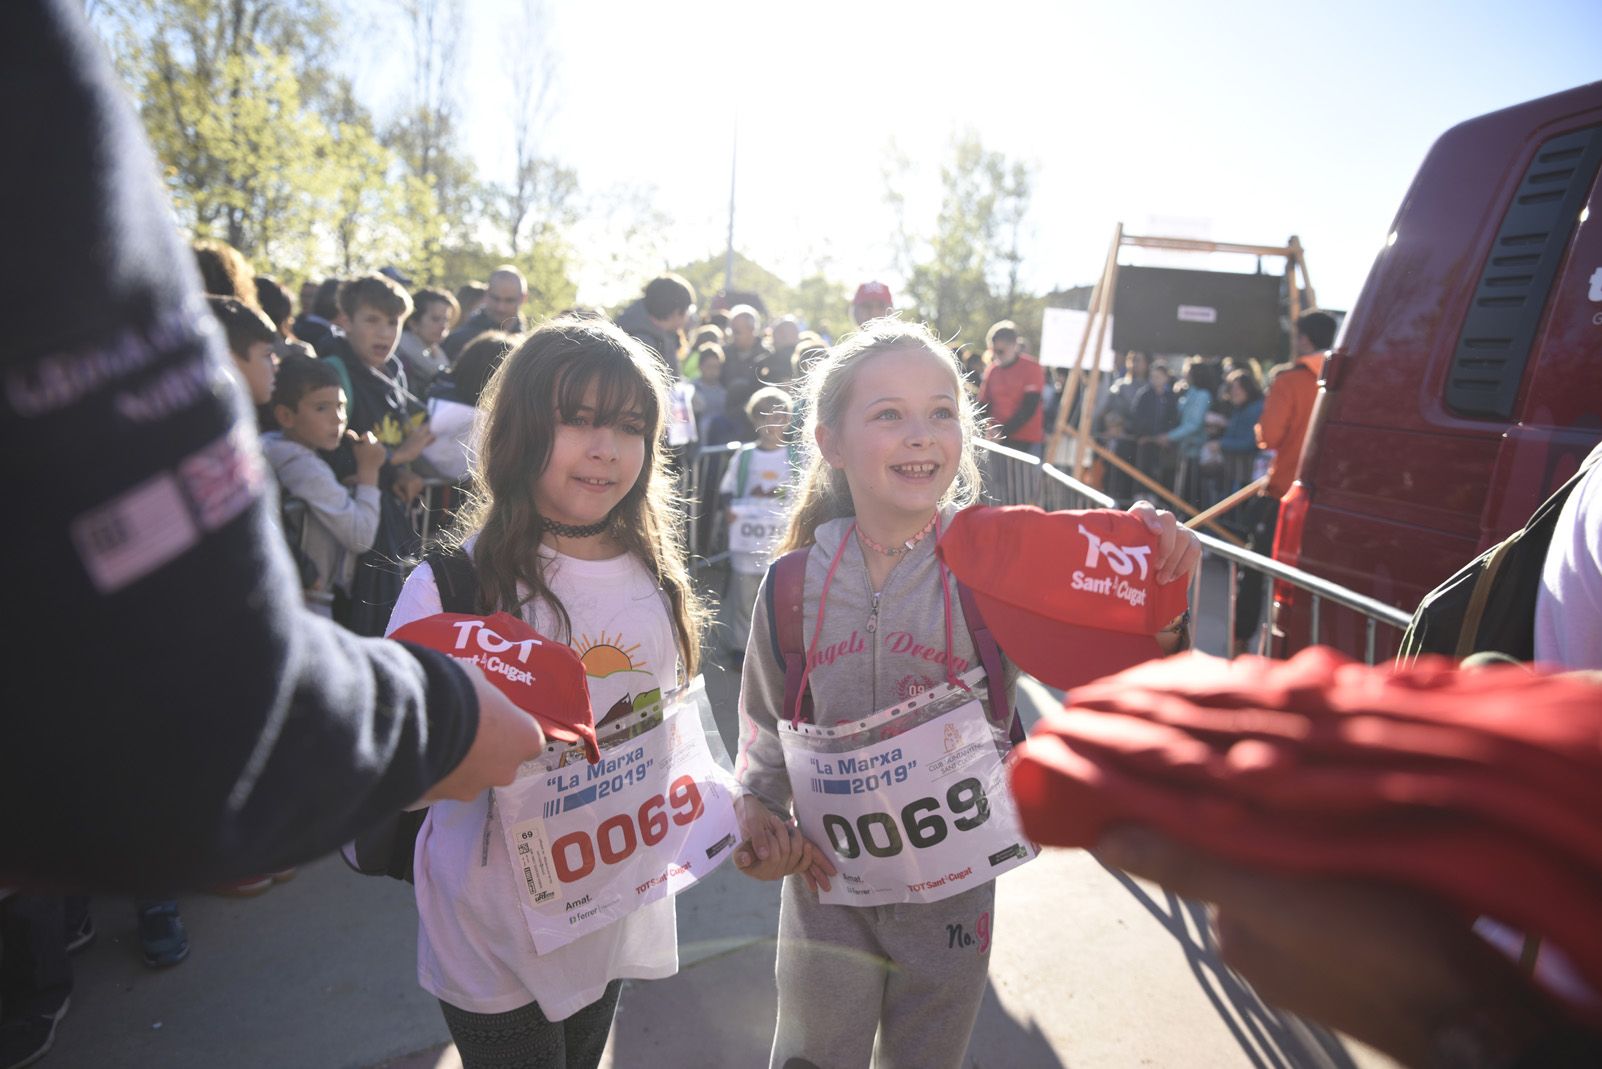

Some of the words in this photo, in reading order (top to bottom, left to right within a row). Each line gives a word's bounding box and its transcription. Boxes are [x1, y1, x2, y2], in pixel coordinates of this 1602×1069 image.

[1078, 523, 1151, 581] TOT
[1071, 570, 1113, 596] Sant
[1116, 580, 1147, 606] Cugat
[453, 620, 542, 664] TOT
[812, 630, 865, 669] ngels
[486, 656, 536, 686] Cugat
[586, 747, 644, 781] Marxa
[837, 748, 902, 775] Marxa
[521, 831, 533, 840] 69
[551, 774, 704, 884] 0069
[822, 777, 990, 859] 0069
[907, 884, 926, 893] TOT
[926, 878, 946, 890] Sant
[948, 866, 973, 882] Cugat
